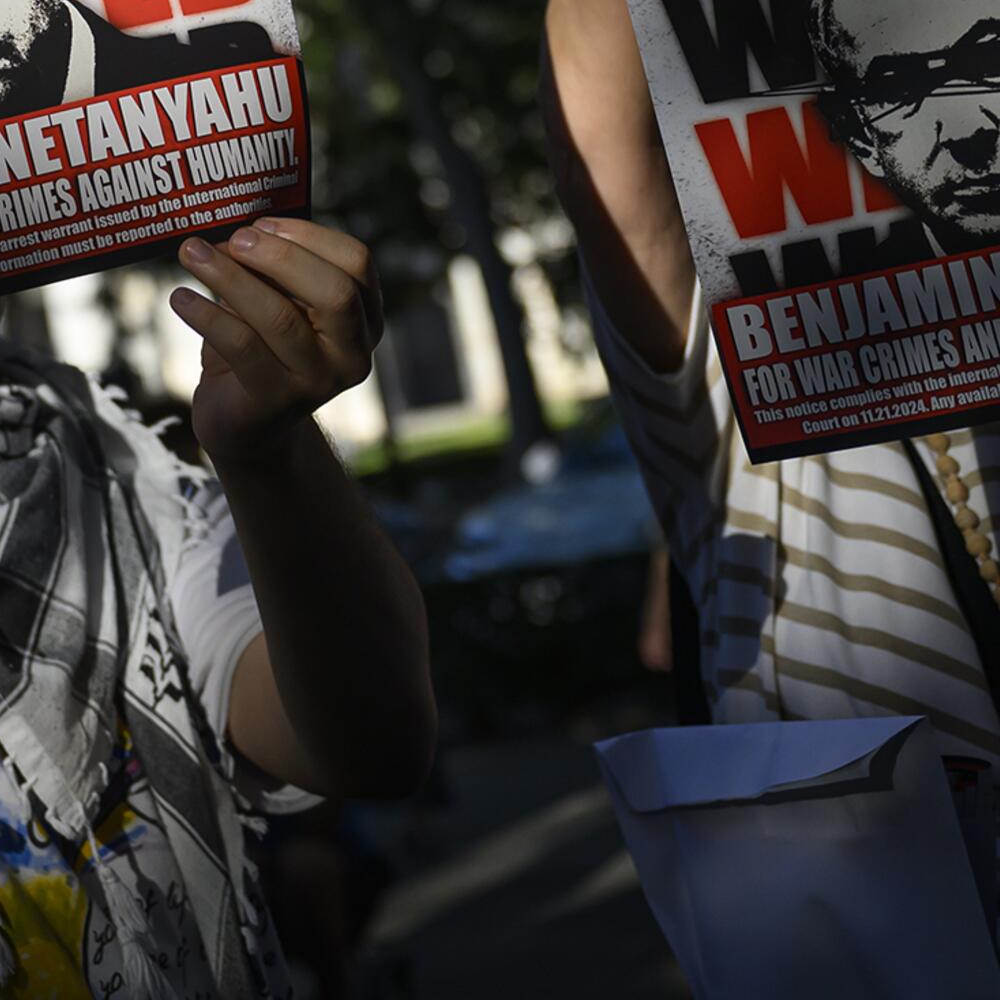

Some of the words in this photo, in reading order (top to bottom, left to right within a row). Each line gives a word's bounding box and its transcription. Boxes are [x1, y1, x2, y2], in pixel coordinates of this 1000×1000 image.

[76, 150, 183, 214] AGAINST
[184, 127, 299, 186] HUMANITY.
[0, 228, 41, 251] arrest
[41, 217, 94, 243] warrant
[94, 206, 139, 229] issued
[139, 202, 158, 221] by
[157, 197, 182, 213] the
[182, 176, 263, 208] International
[262, 170, 299, 191] Criminal
[60, 238, 96, 259] must
[96, 231, 114, 247] be
[114, 218, 174, 246] reported
[174, 213, 190, 230] to
[189, 208, 214, 226] the
[743, 362, 798, 407] FOR
[793, 349, 860, 397] WAR
[858, 328, 961, 385] CRIMES
[754, 406, 785, 425] This
[785, 400, 828, 420] notice
[828, 386, 893, 412] complies
[891, 379, 923, 397] with
[923, 374, 948, 391] the
[802, 418, 842, 435] Court
[841, 414, 860, 429] on
[860, 398, 930, 425] 11.21.2024.
[930, 394, 957, 413] Any
